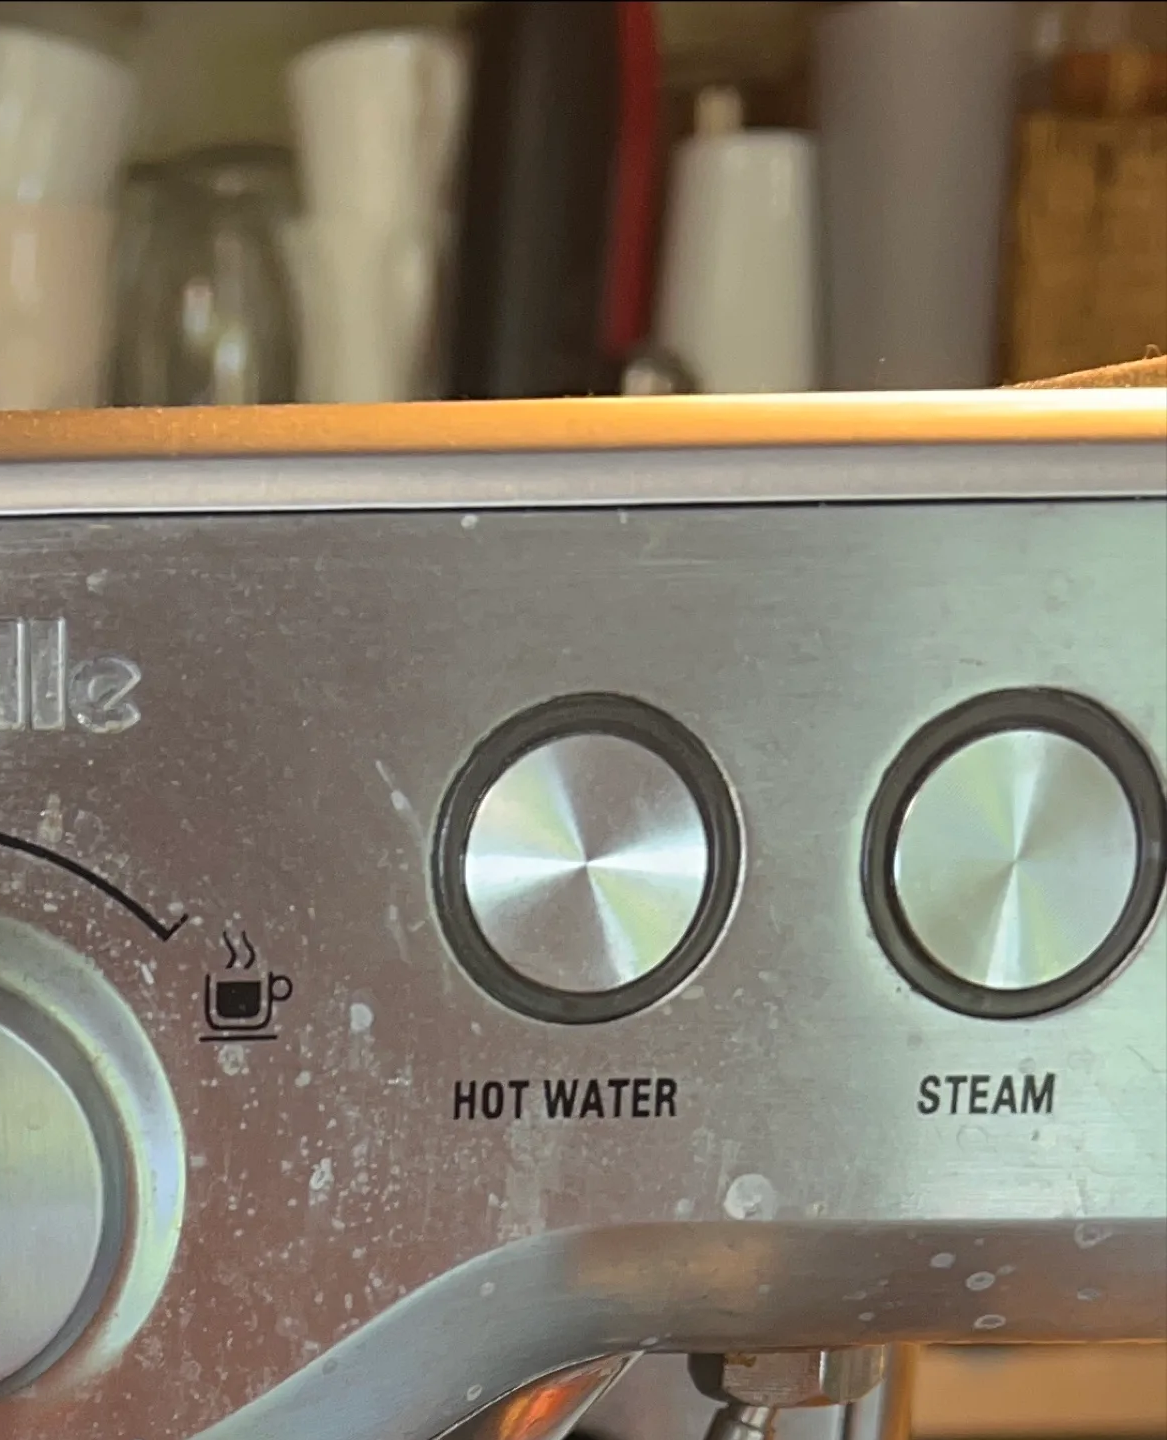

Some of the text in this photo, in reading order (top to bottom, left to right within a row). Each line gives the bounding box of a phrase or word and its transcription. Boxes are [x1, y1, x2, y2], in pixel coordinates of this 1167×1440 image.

[453, 1077, 678, 1120] HOT WATER
[916, 1073, 1055, 1115] STEAM
